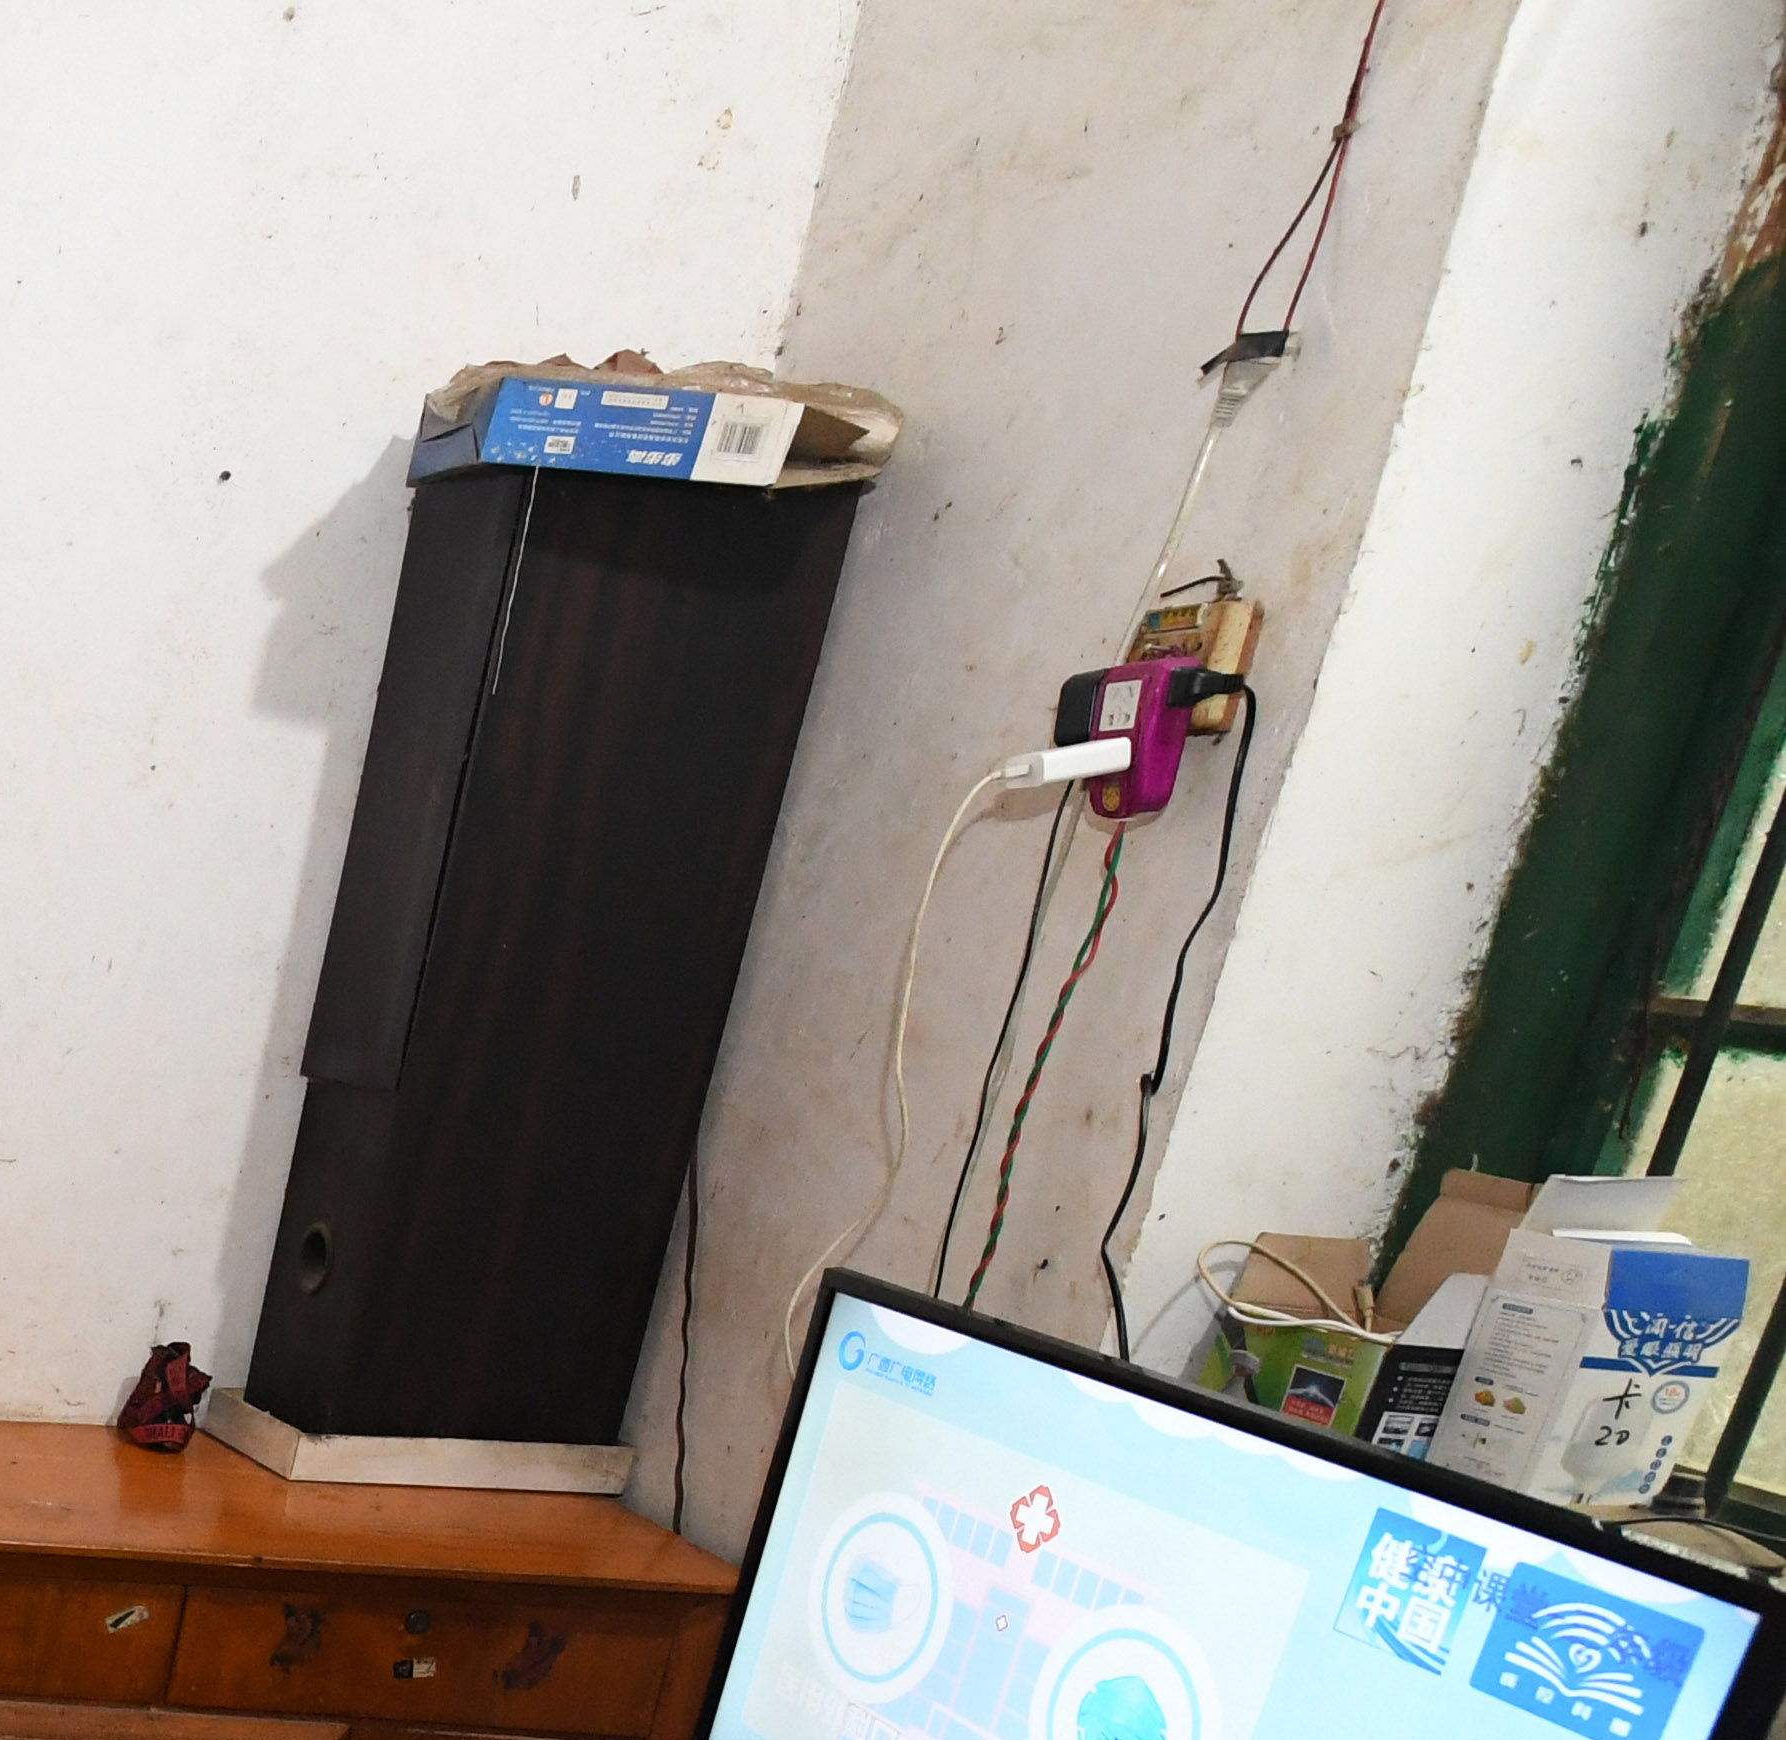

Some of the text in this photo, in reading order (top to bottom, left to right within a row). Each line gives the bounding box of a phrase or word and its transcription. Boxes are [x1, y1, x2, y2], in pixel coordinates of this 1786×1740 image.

[866, 1351, 938, 1392] 广西广电网络
[1356, 1582, 1452, 1655] 中国
